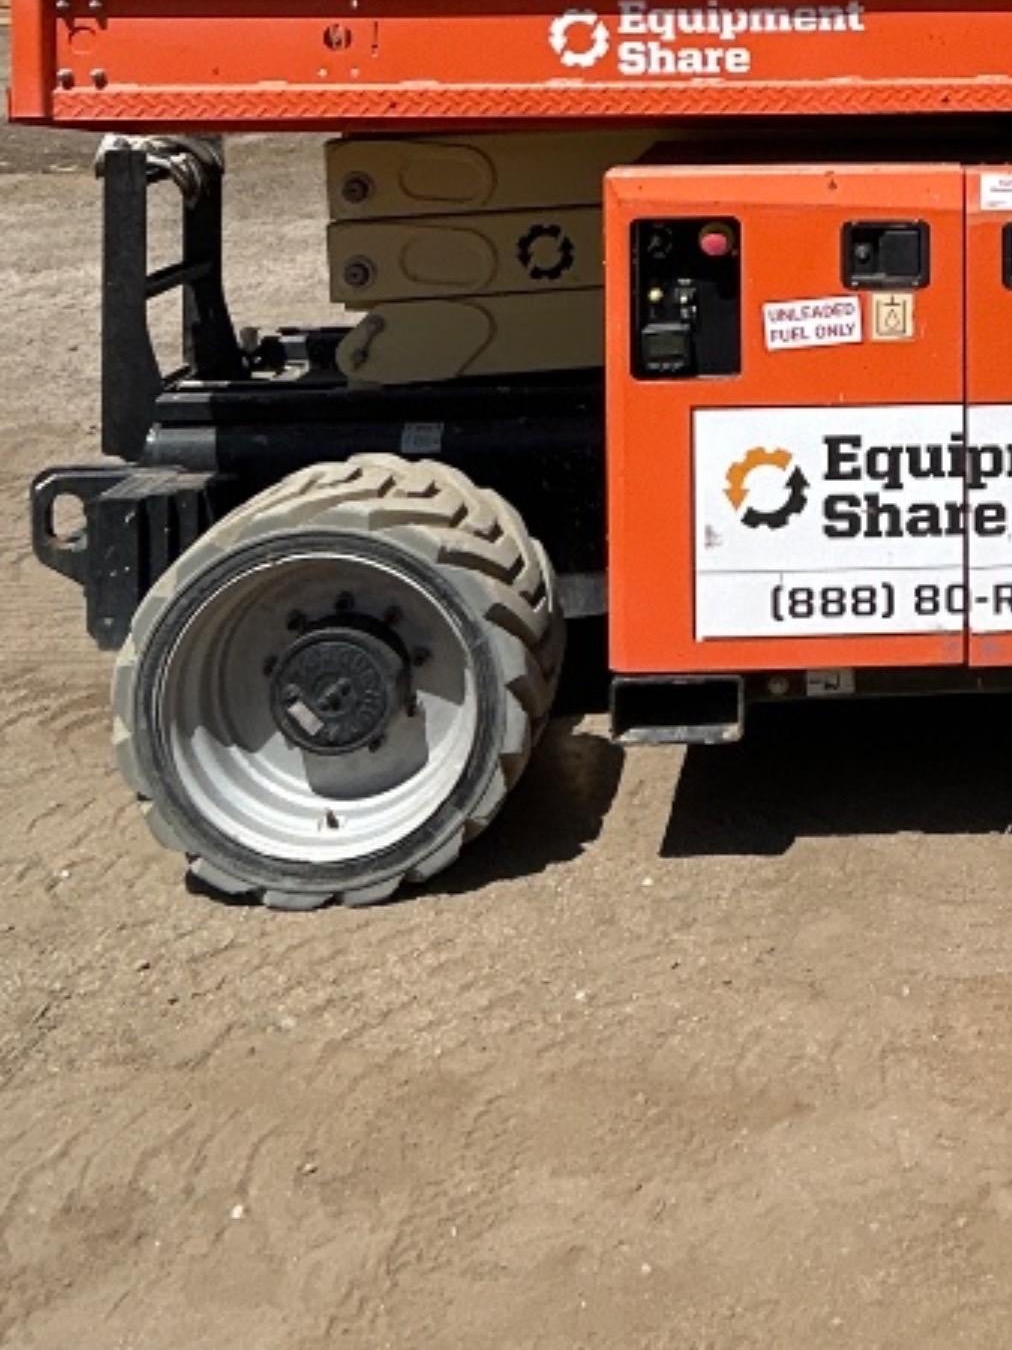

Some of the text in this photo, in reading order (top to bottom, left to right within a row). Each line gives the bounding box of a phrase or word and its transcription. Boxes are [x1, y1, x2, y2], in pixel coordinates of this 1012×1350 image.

[617, 0, 865, 40] Equipment
[617, 41, 751, 76] Share
[768, 303, 855, 322] UNLEADED
[770, 323, 856, 343] FUEL ONLY
[822, 493, 1008, 539] Share
[770, 582, 897, 622] (888)
